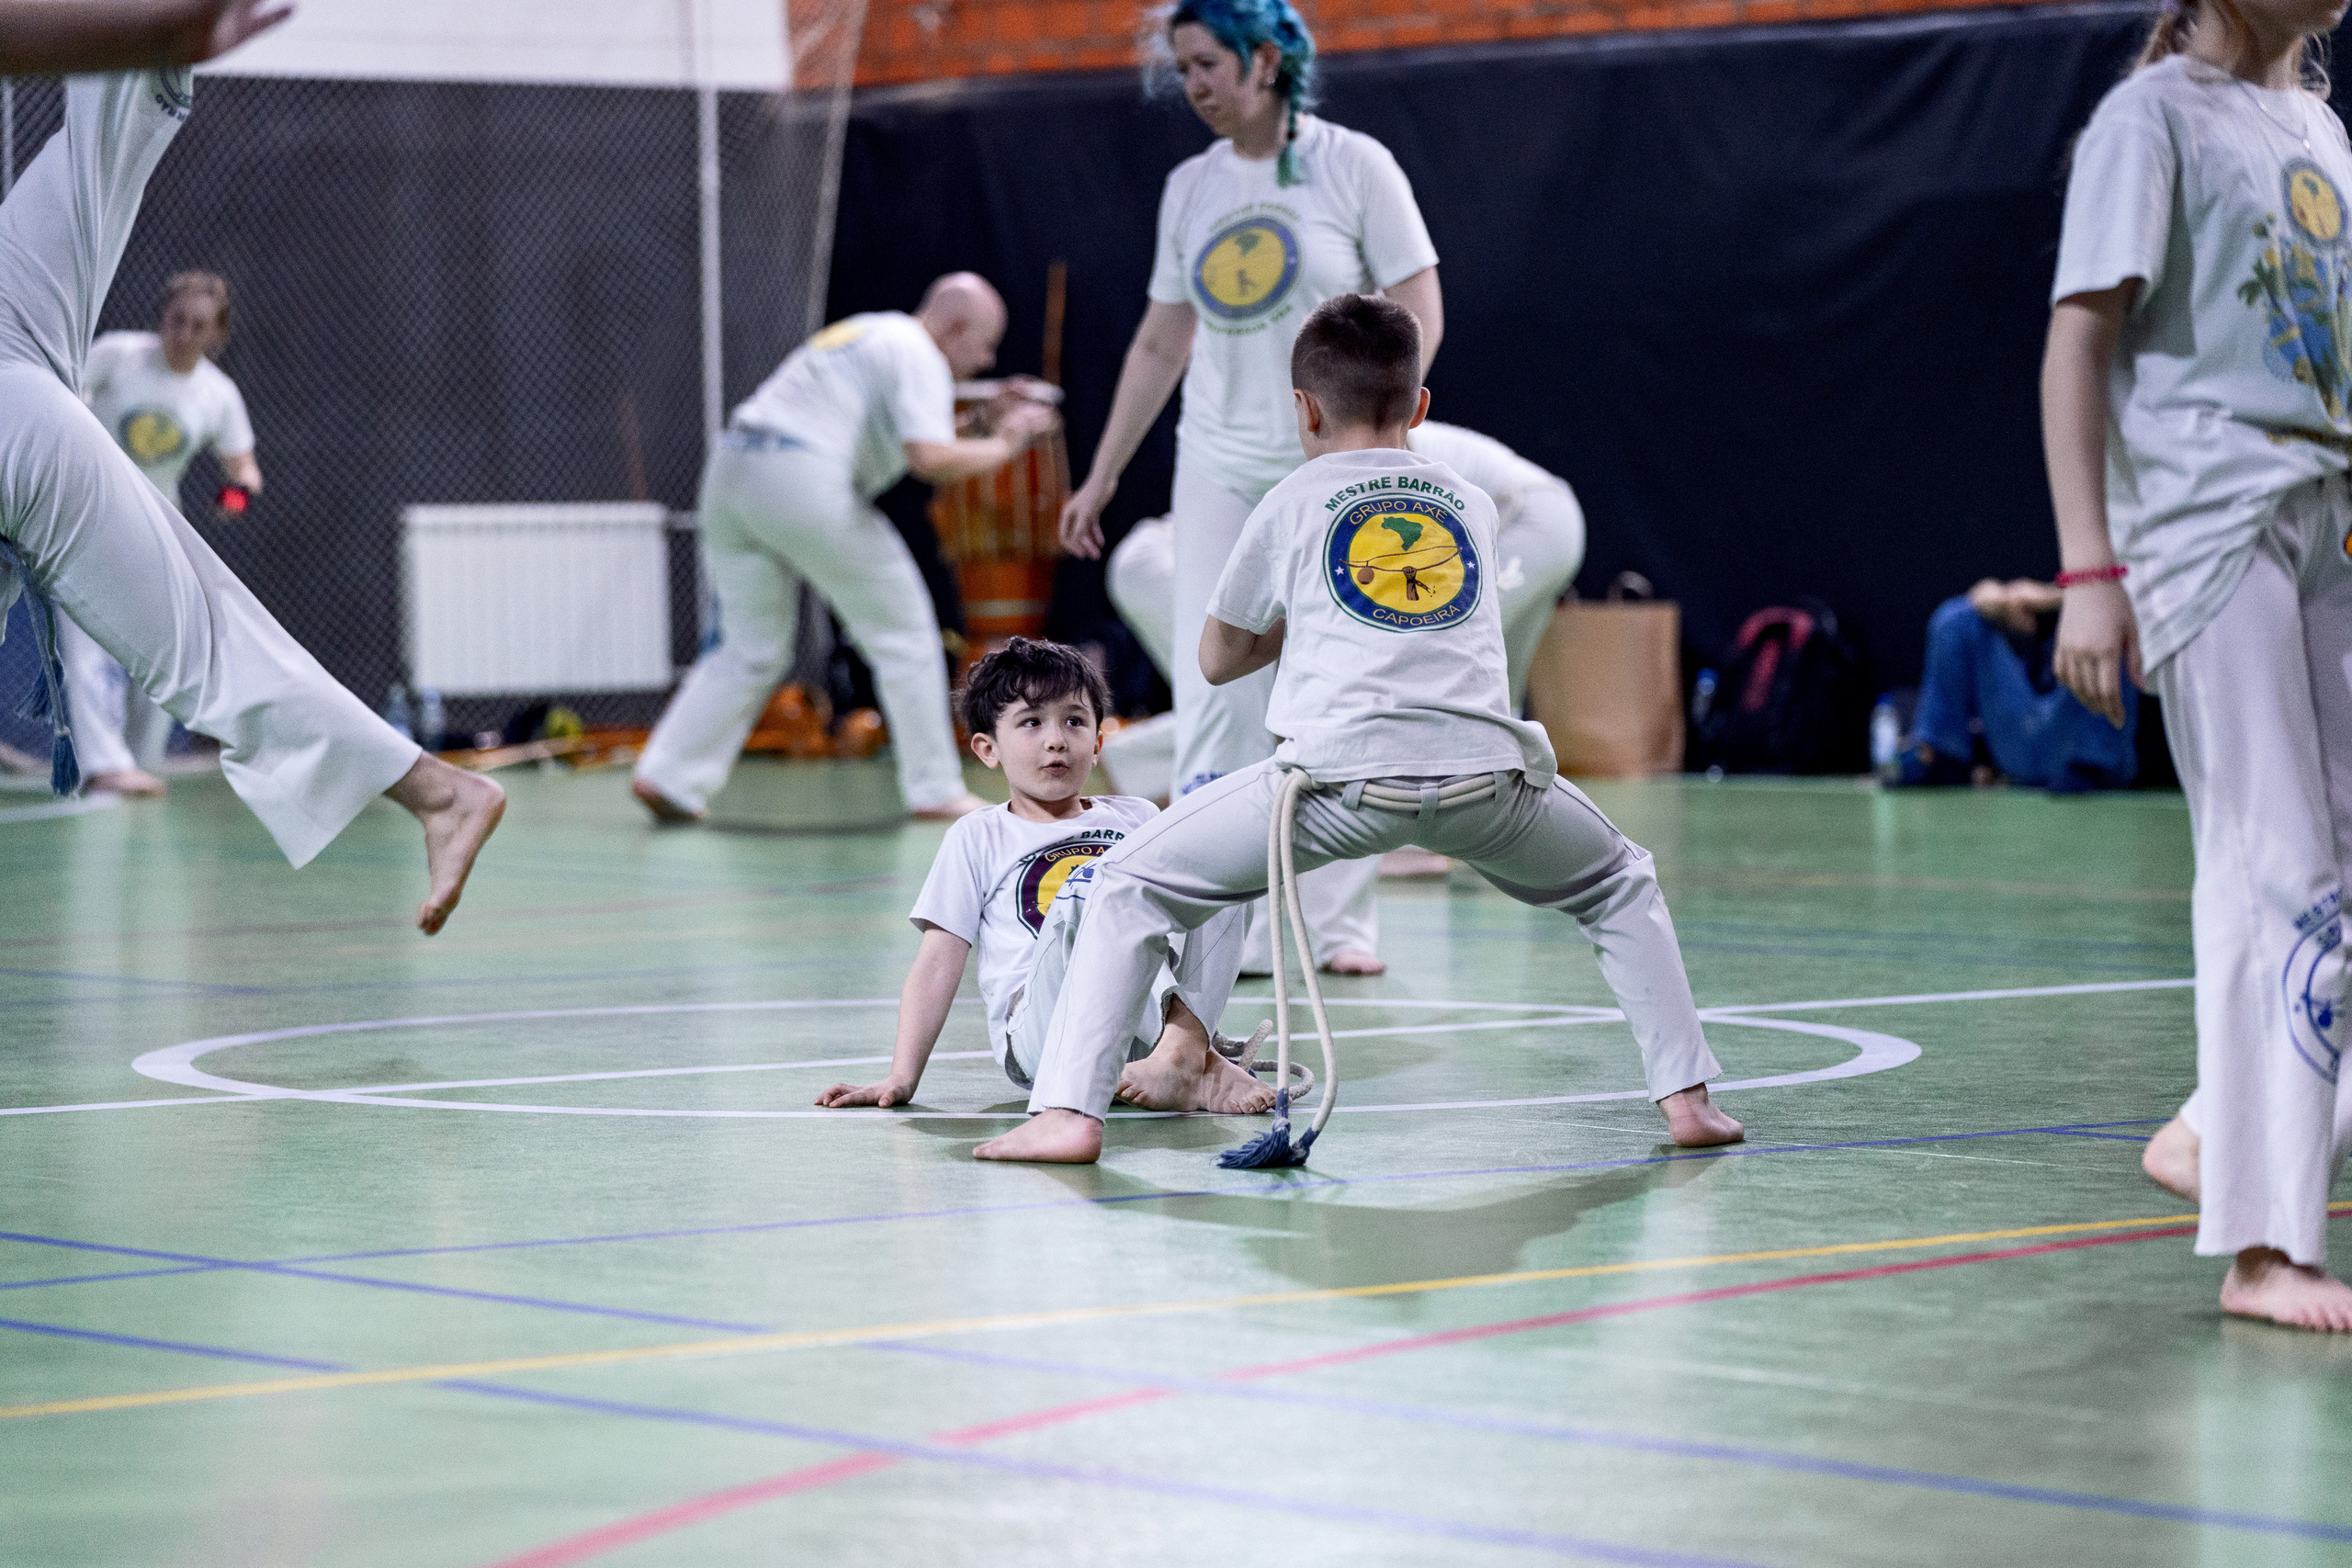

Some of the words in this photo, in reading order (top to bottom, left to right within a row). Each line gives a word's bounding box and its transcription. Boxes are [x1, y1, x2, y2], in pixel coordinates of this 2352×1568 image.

[1324, 476, 1392, 512] MESTRE
[1397, 476, 1465, 512] BARRÃO
[1349, 501, 1407, 525] GRUPO
[1412, 502, 1448, 524] AXÉ
[1373, 604, 1461, 626] CAPOEIRA
[1080, 829, 1125, 840] BARR
[1045, 846, 1092, 862] GRUPO
